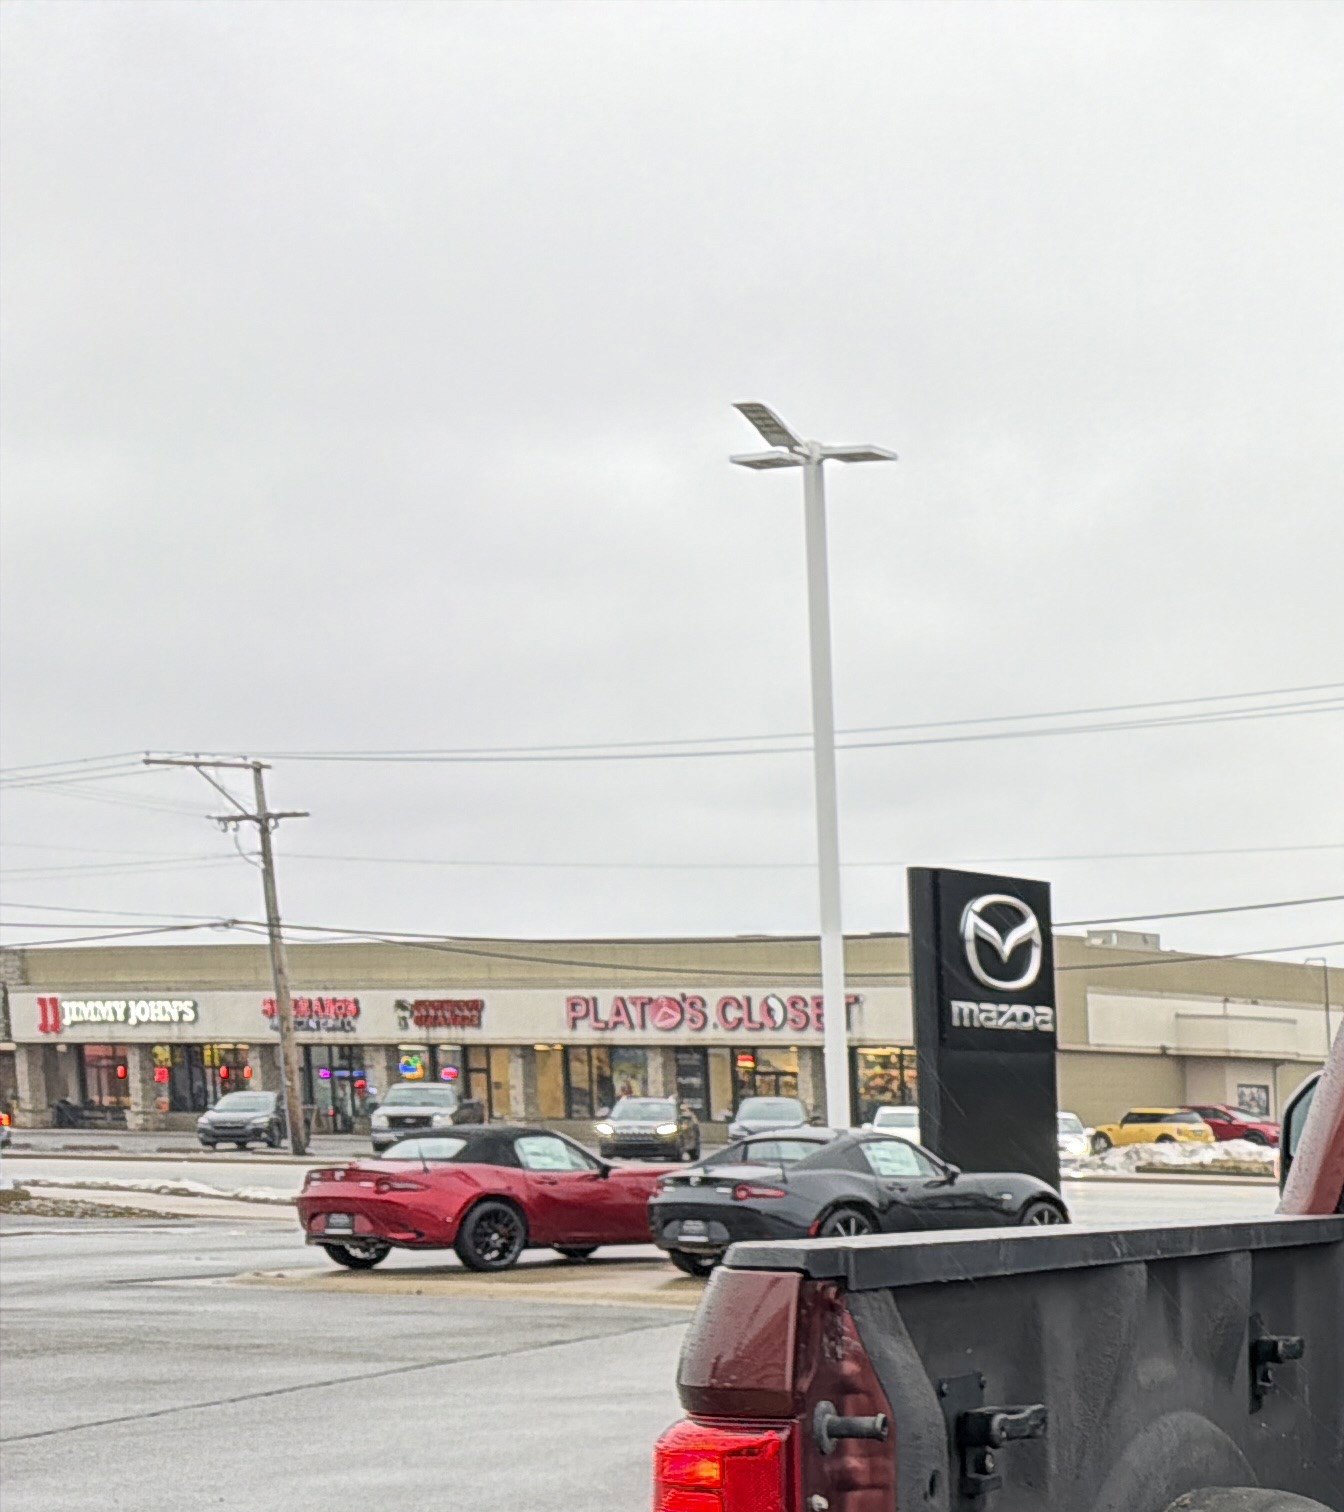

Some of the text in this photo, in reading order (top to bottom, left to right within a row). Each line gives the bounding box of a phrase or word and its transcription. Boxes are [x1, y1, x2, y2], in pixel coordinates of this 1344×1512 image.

[61, 1000, 196, 1026] JIMMY JOHN'S
[565, 994, 707, 1032] PLATO'S
